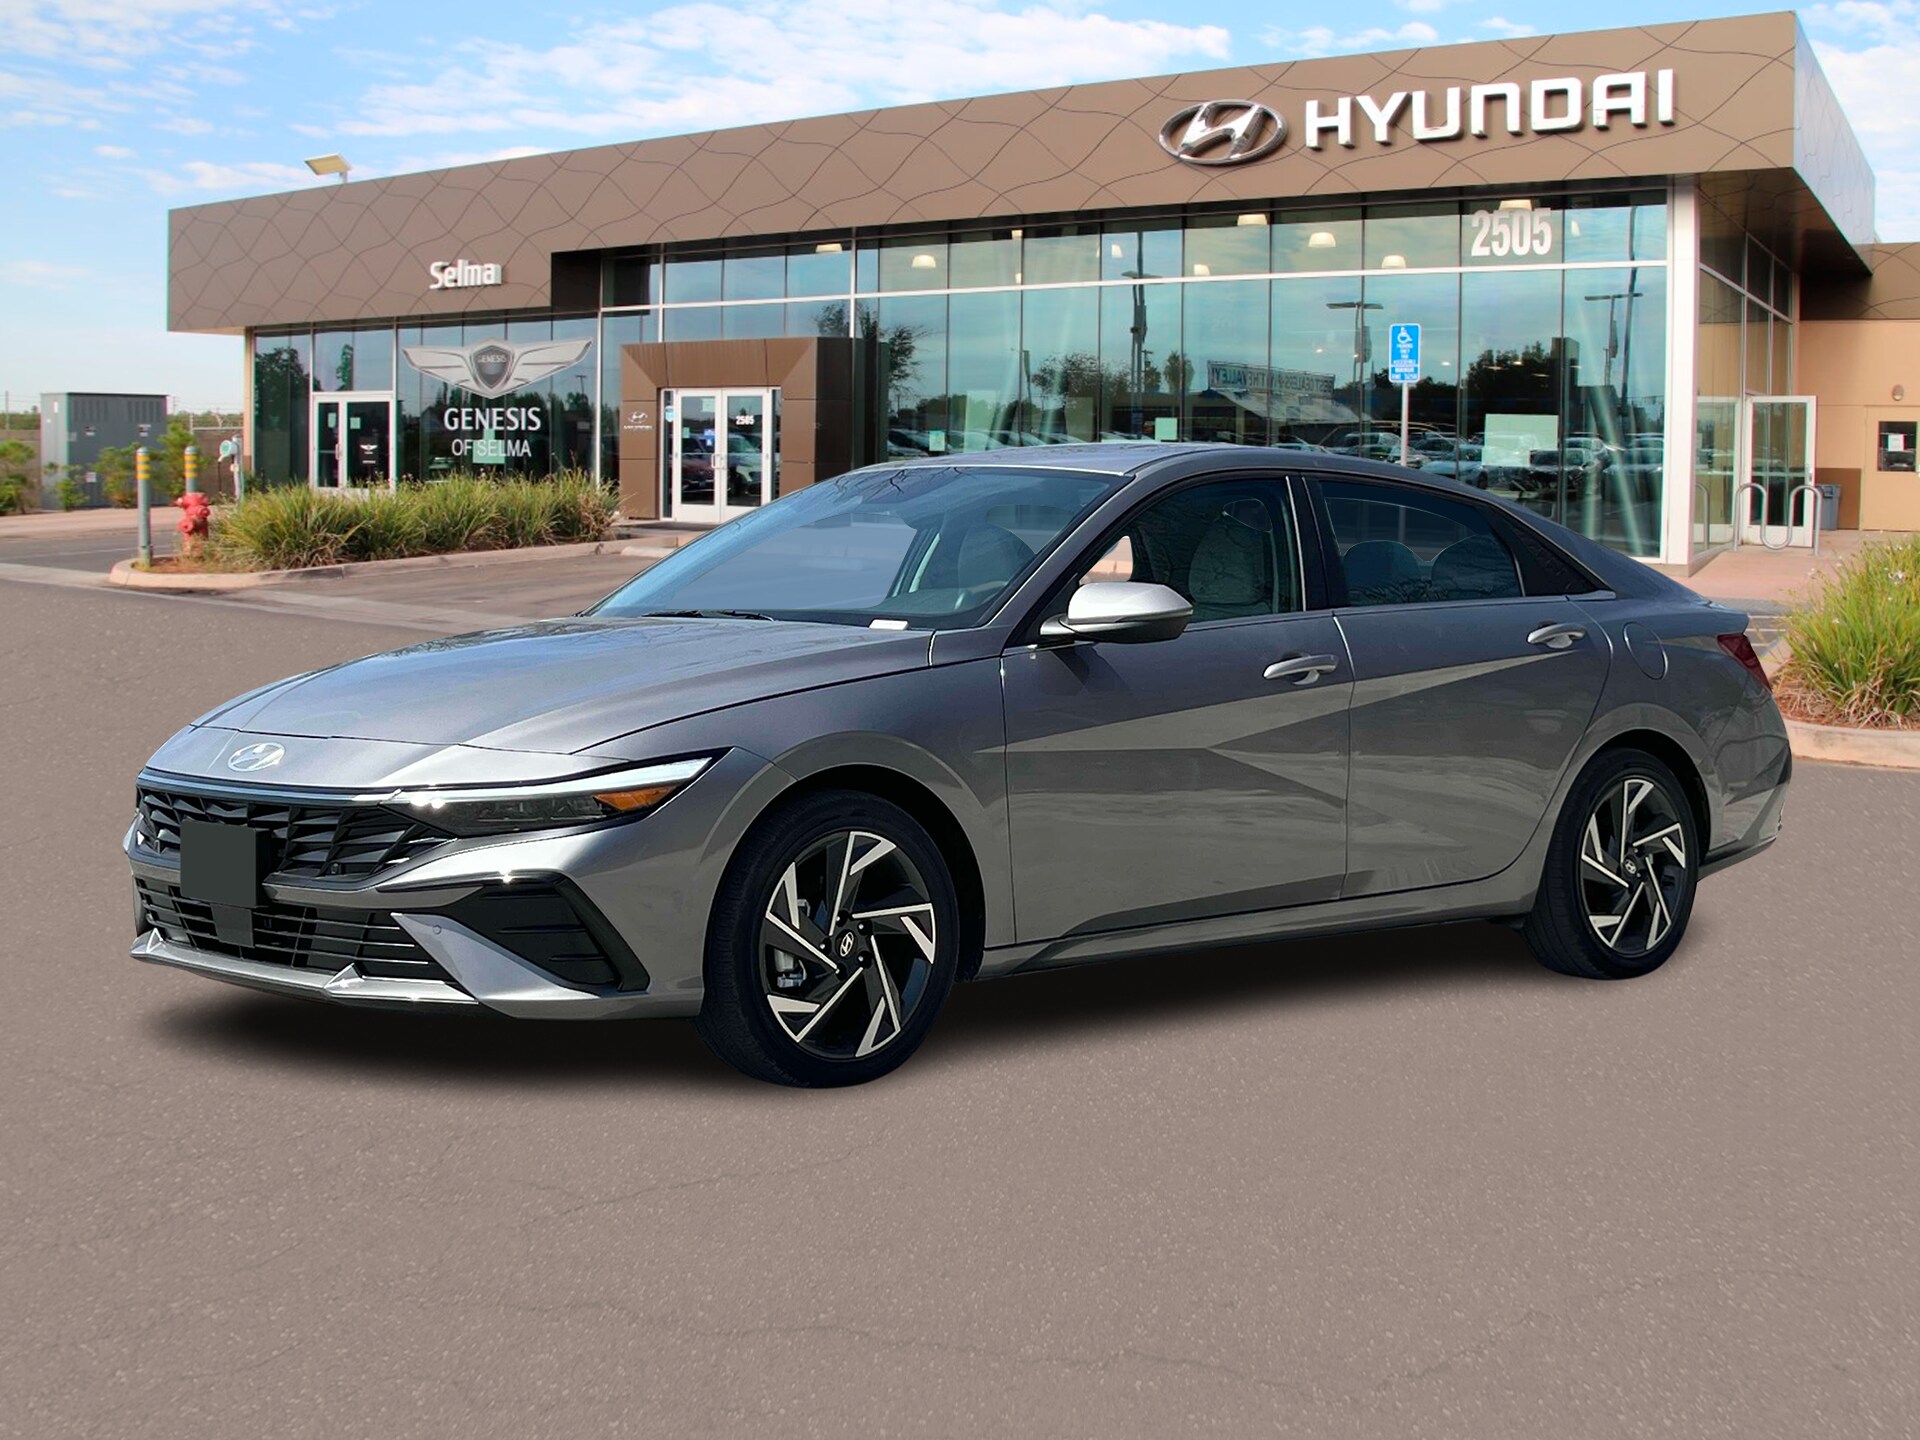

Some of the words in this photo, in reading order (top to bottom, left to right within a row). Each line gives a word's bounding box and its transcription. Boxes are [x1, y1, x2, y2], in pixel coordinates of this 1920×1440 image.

[1305, 68, 1675, 149] HYUNDAI
[1470, 206, 1553, 257] 2505
[428, 258, 502, 290] Selma
[443, 406, 542, 431] GENESIS
[451, 439, 473, 457] OF
[476, 438, 532, 458] SELMA
